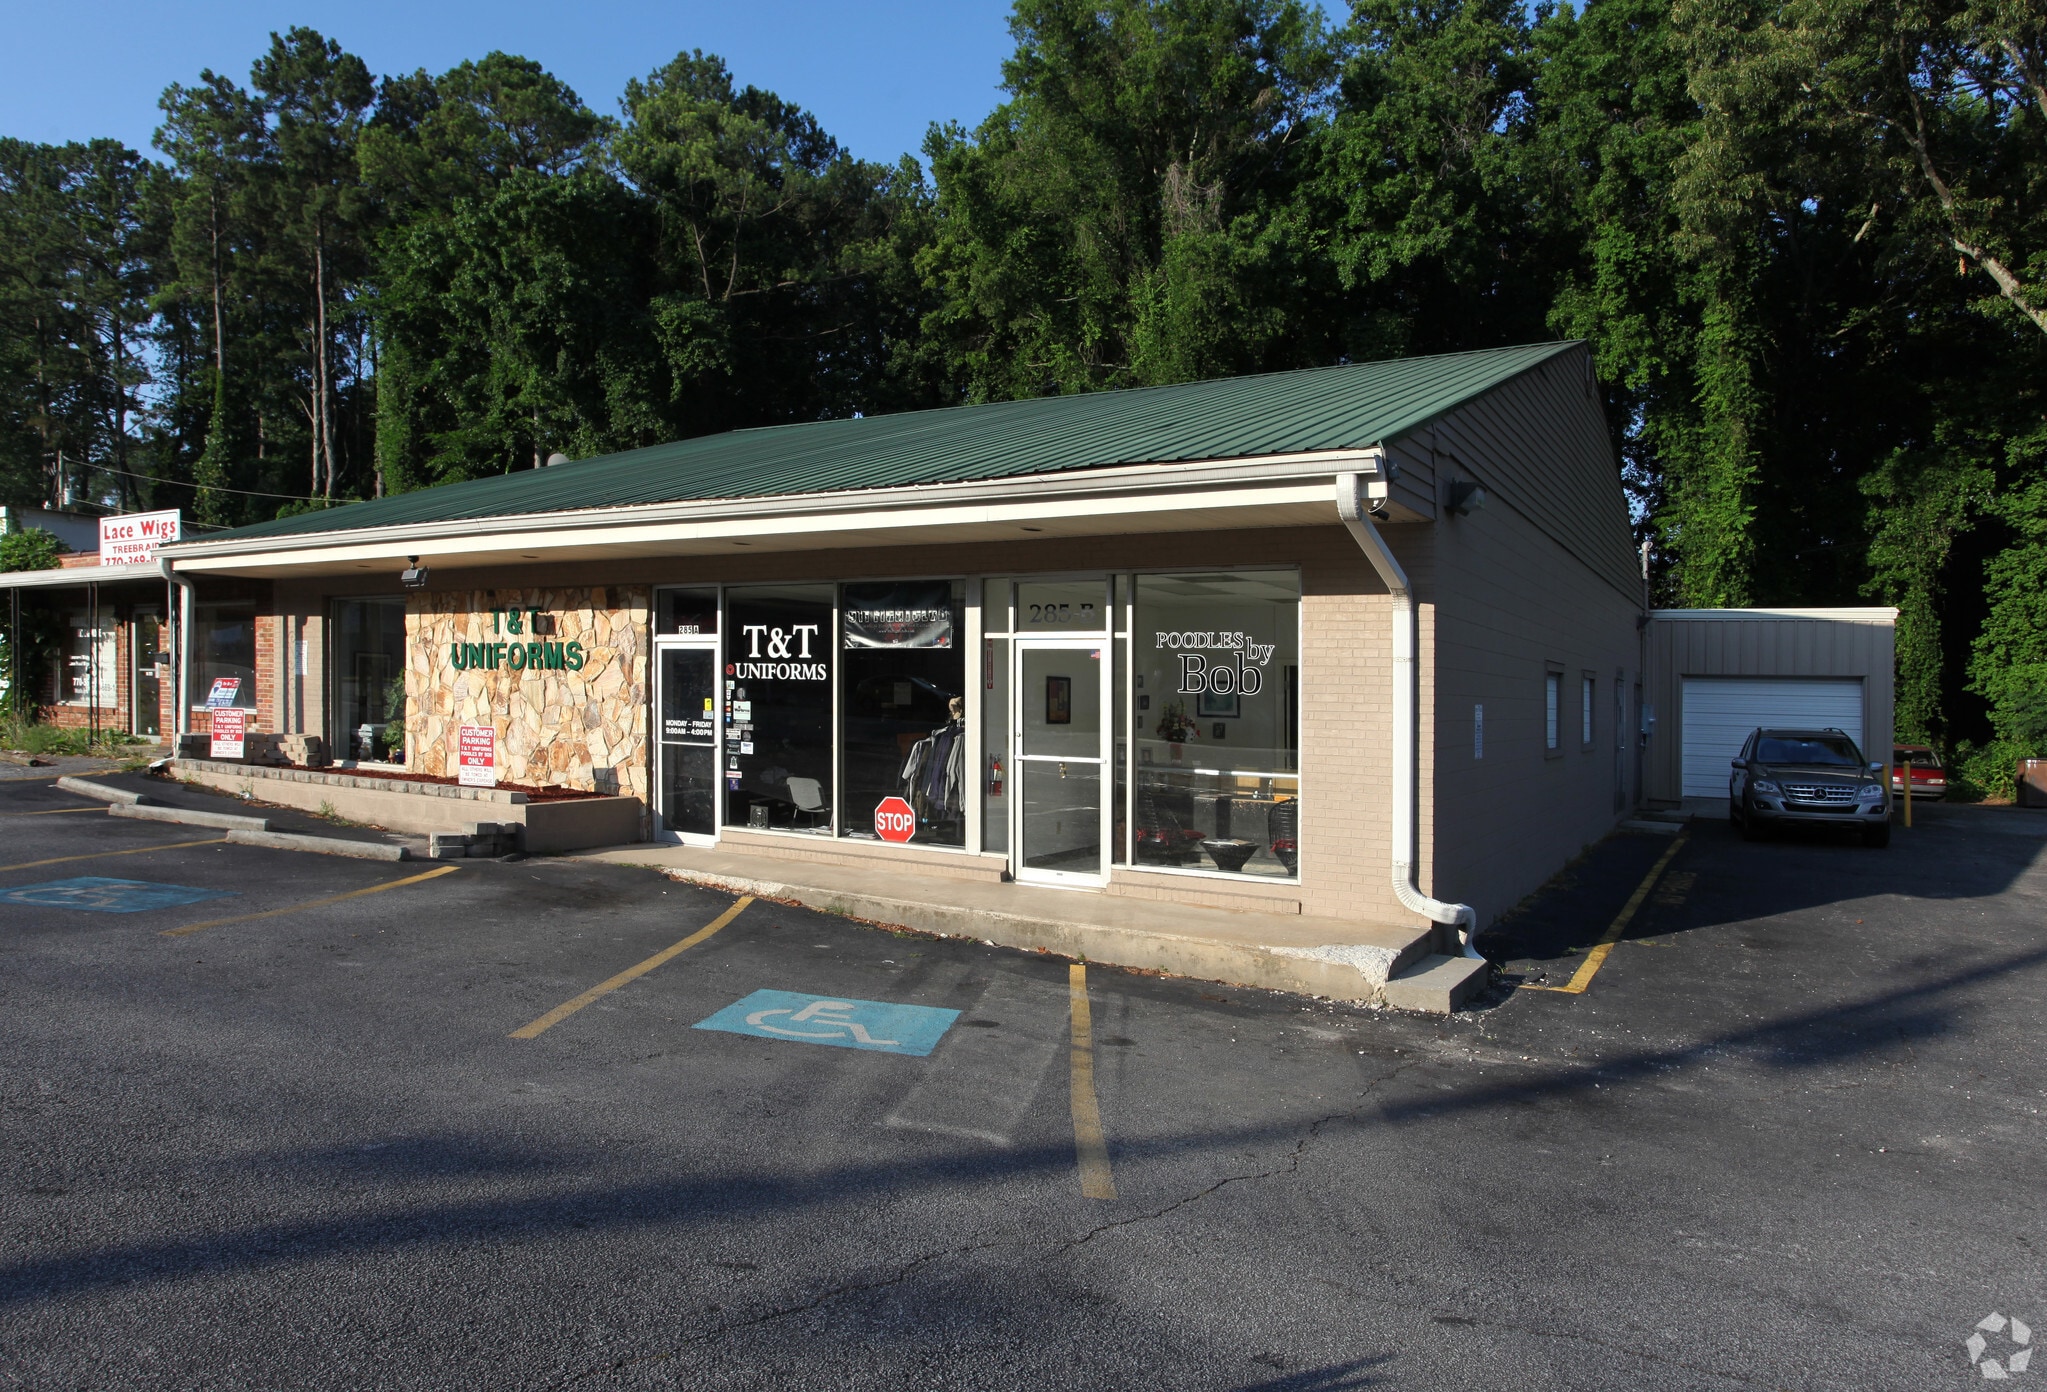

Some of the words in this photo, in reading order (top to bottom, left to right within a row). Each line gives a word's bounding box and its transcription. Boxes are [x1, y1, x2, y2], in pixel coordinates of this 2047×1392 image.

[104, 525, 133, 540] Lace
[140, 519, 175, 539] Wigs
[1029, 603, 1096, 623] 285-B
[743, 624, 818, 659] T&T
[1155, 631, 1244, 649] POODLES
[1245, 636, 1275, 666] by
[451, 641, 584, 671] UNIFORMS
[735, 662, 827, 681] UNIFORMS
[1177, 651, 1263, 696] Bob
[462, 728, 493, 737] CUSTOMER
[665, 719, 687, 727] MONDAY
[692, 720, 712, 728] FRIDAY
[462, 737, 490, 745] PARKING
[877, 812, 912, 832] STOP
